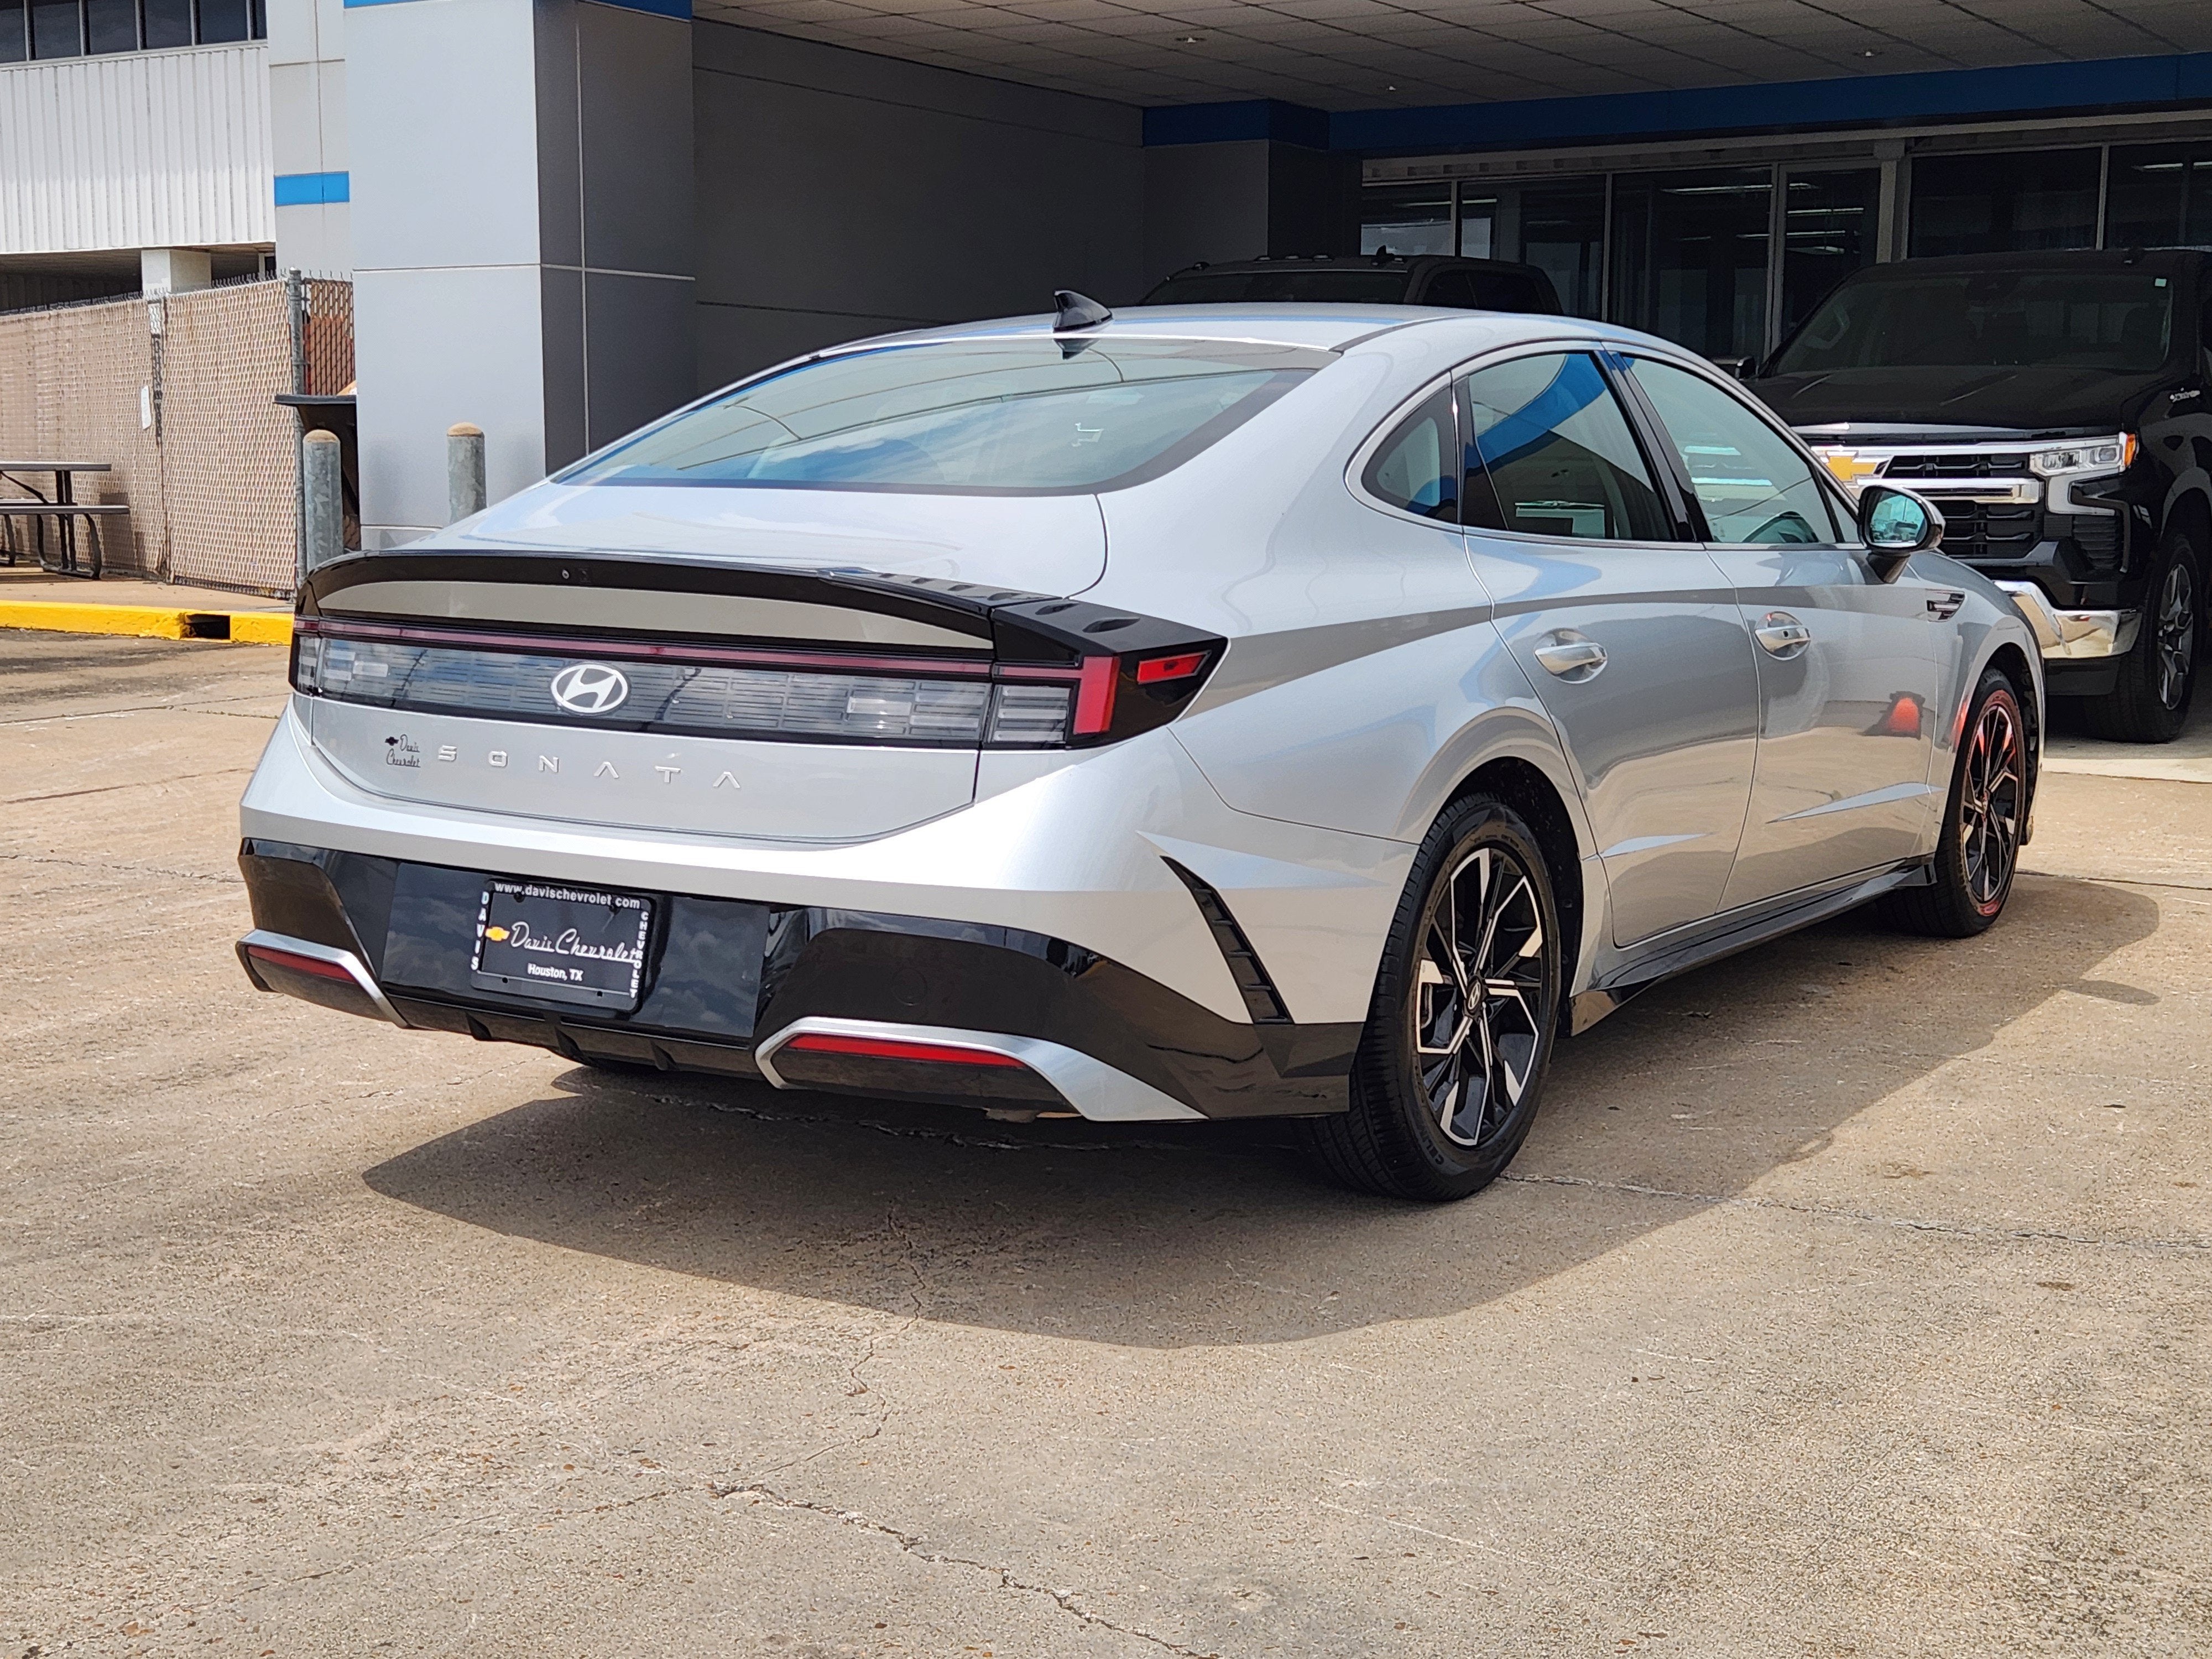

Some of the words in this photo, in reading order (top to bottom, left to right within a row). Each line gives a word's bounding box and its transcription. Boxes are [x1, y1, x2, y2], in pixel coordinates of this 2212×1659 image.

[437, 744, 740, 789] SONATA
[494, 883, 640, 909] www.davischevroletcom
[471, 891, 489, 971] DAVIS
[510, 921, 555, 953] Davis
[555, 928, 638, 964] Chevrolet
[527, 962, 568, 981] Houston,
[568, 968, 584, 982] TX
[629, 911, 649, 998] CHEVROLET
